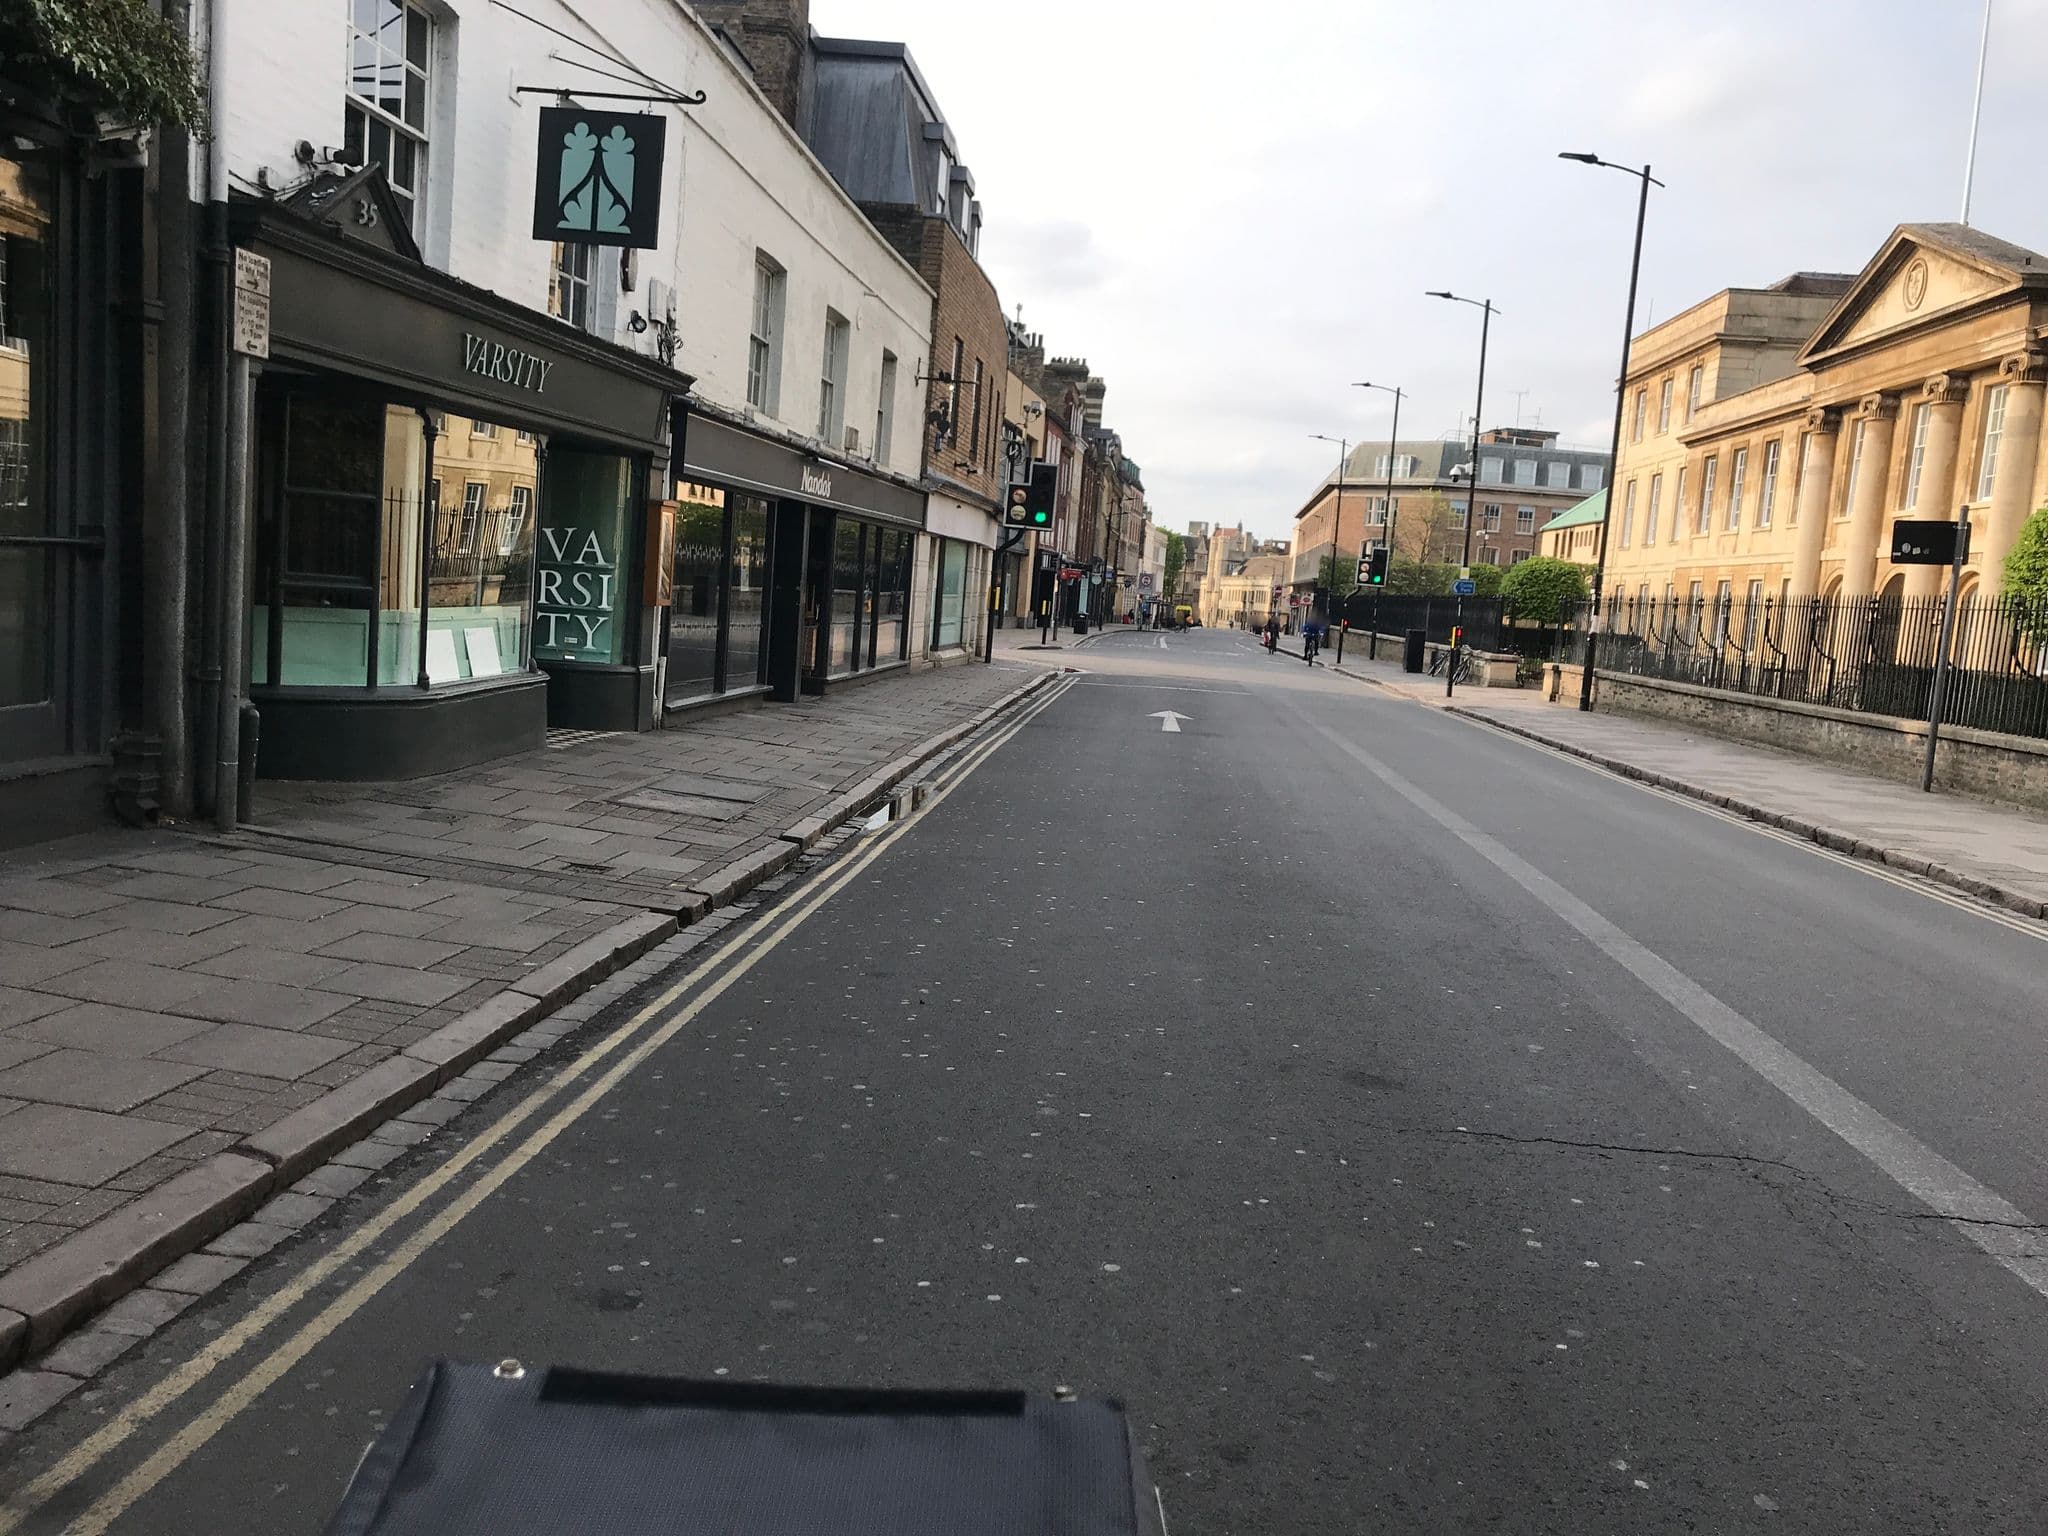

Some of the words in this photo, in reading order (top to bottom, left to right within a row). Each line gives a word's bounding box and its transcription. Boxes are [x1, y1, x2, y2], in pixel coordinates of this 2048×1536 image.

[359, 199, 378, 228] 35
[238, 251, 247, 262] No
[466, 333, 554, 392] VARSITY
[801, 465, 831, 498] Nando's
[542, 527, 610, 566] VA
[537, 569, 613, 610] RSI
[537, 611, 608, 650] TY
